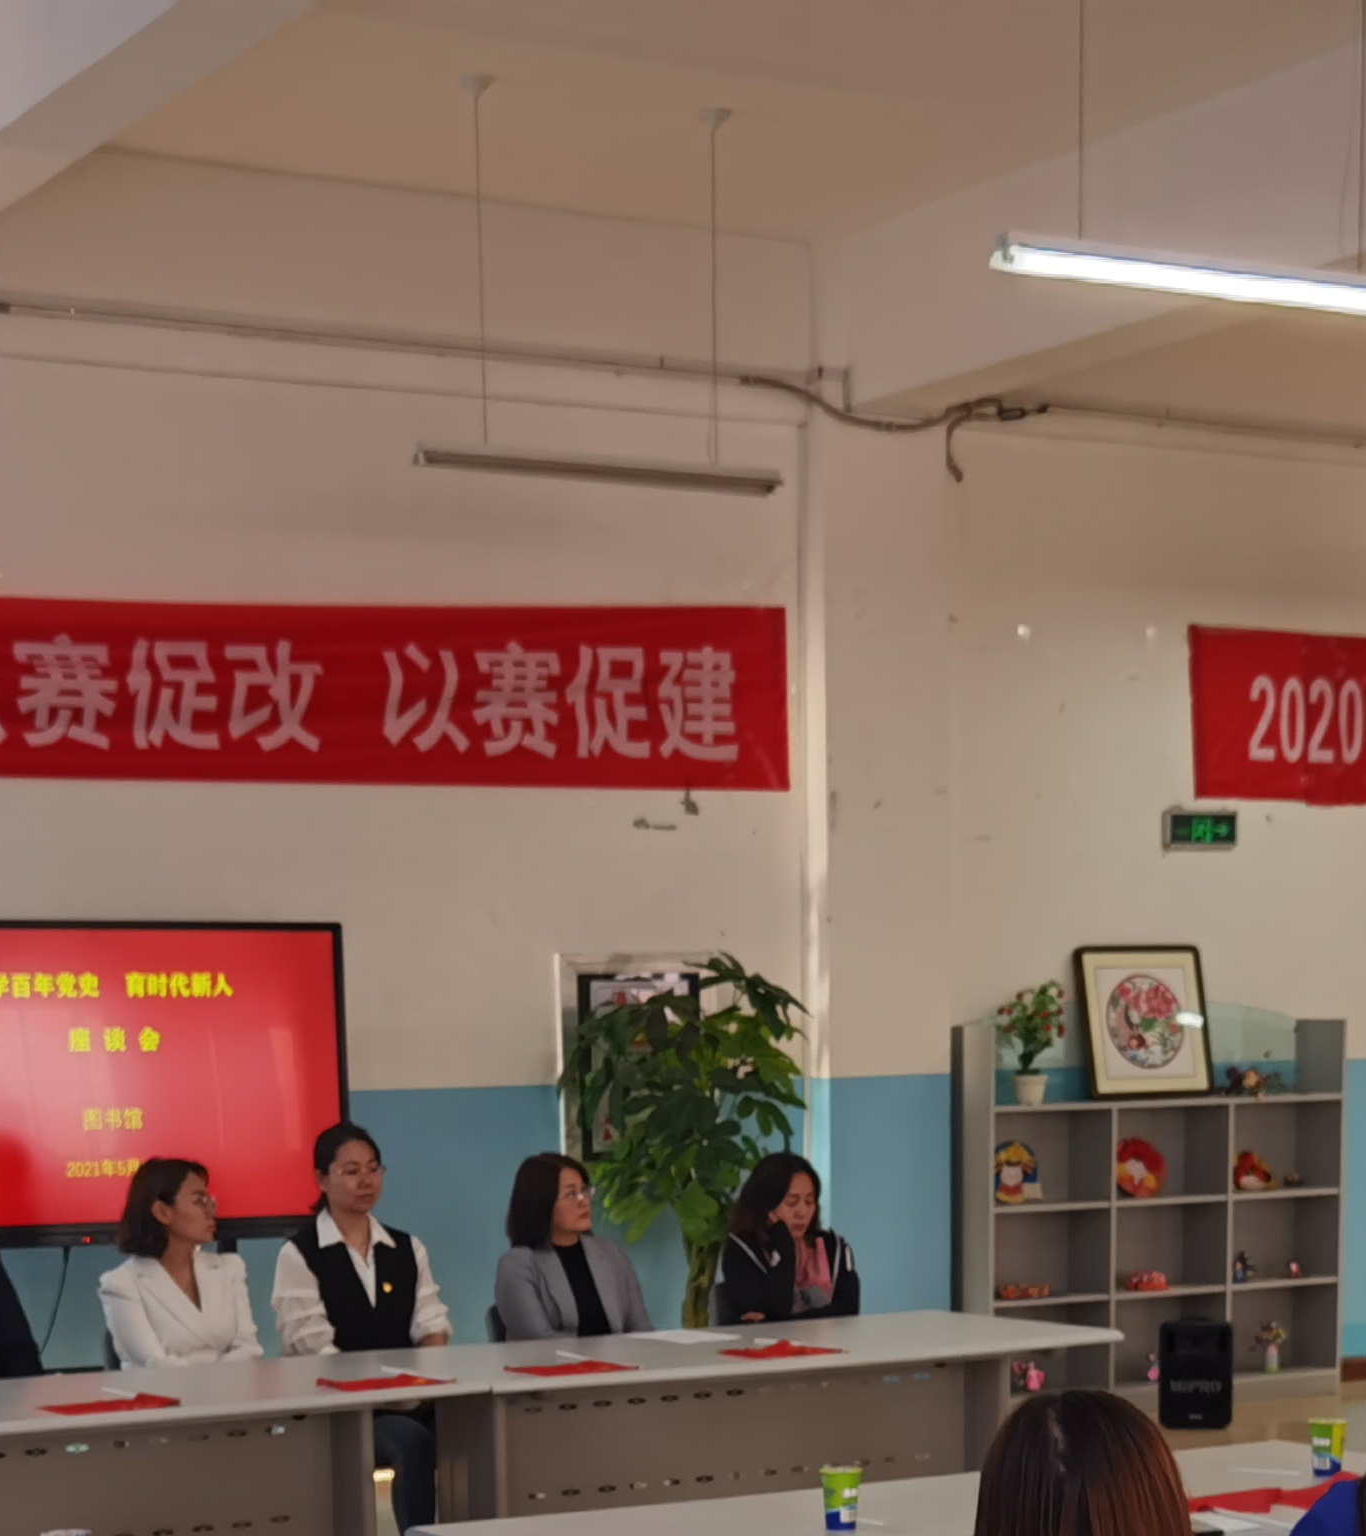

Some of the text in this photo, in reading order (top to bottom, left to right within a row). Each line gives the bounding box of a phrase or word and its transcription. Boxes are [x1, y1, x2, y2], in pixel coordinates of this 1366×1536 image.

[382, 640, 740, 762] 以赛促建
[125, 972, 234, 998] 育时代新人
[83, 1107, 143, 1131] 图书馆
